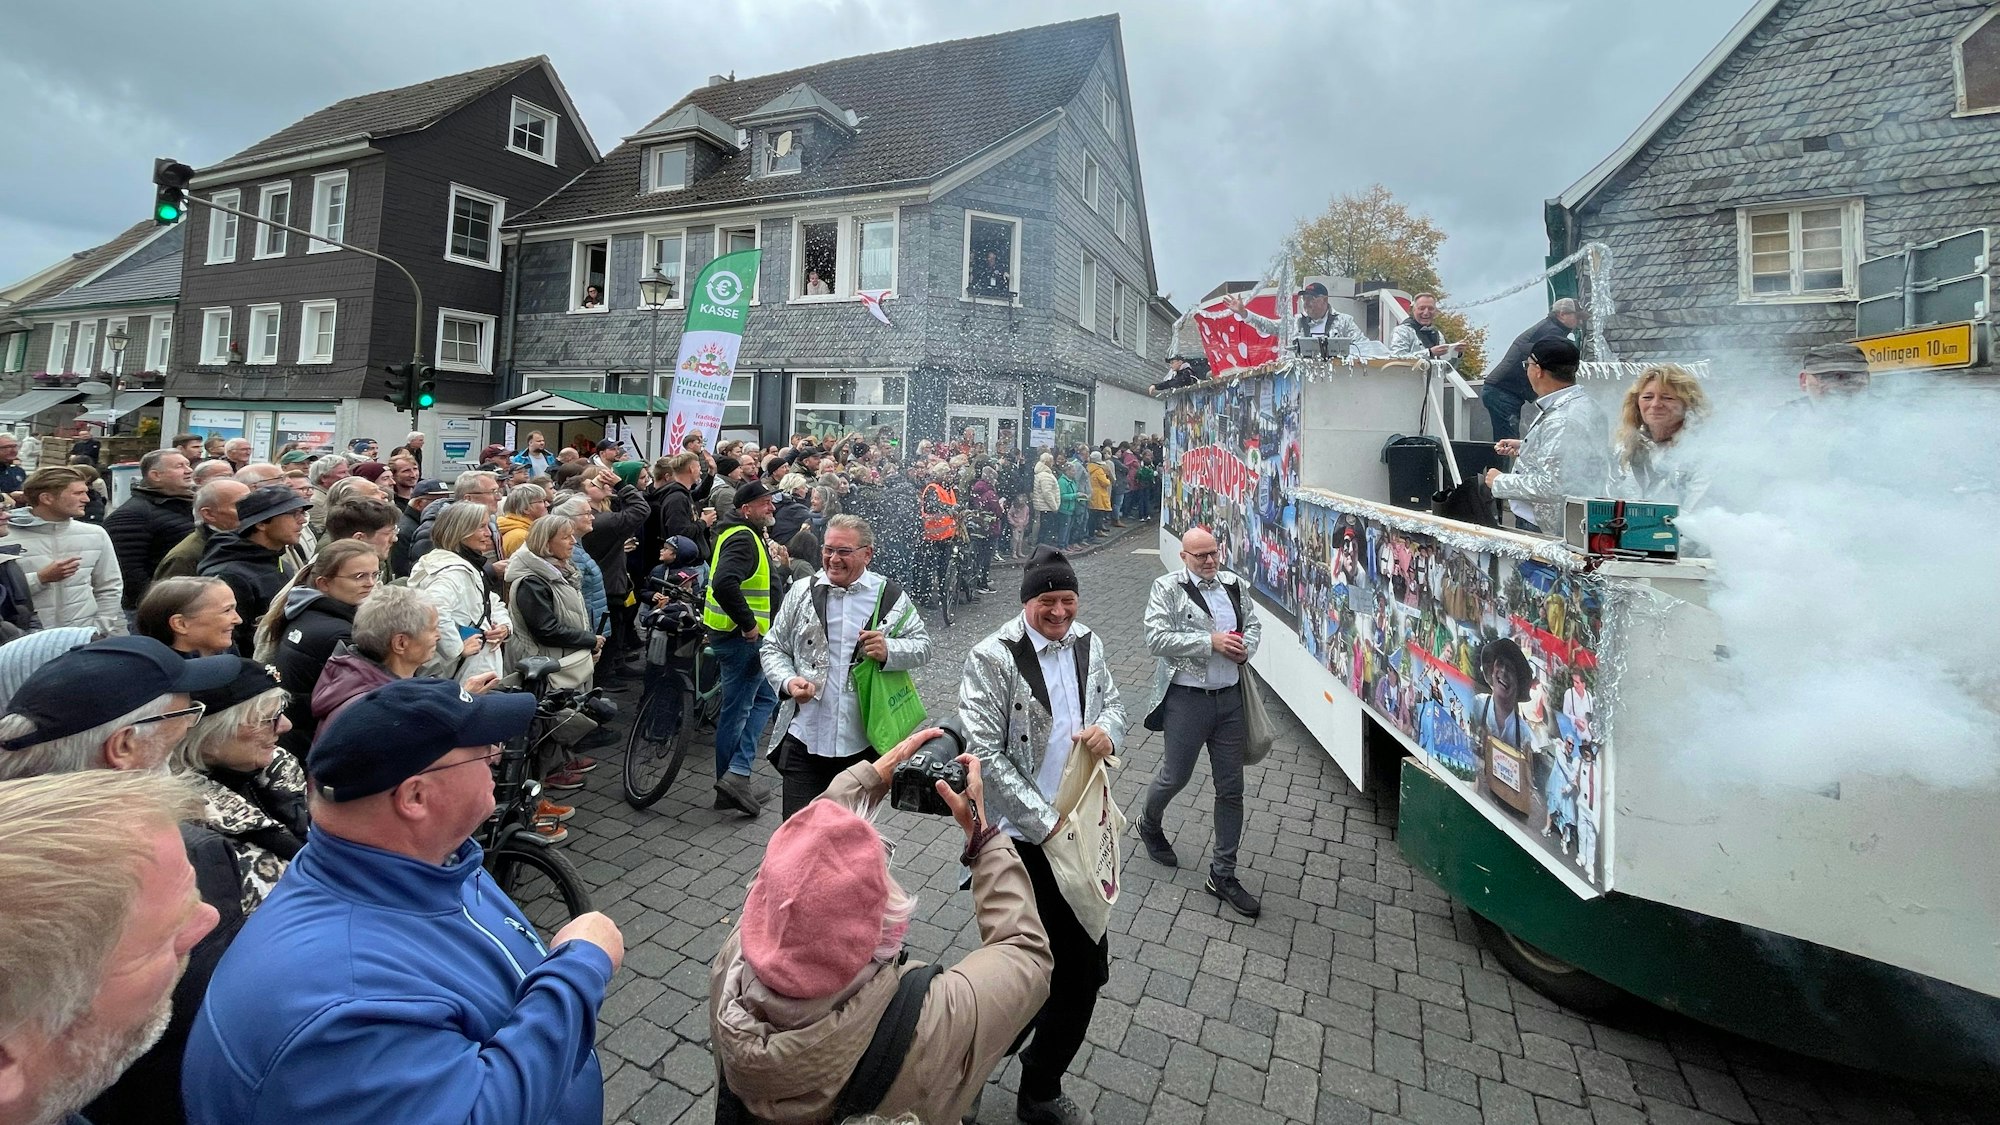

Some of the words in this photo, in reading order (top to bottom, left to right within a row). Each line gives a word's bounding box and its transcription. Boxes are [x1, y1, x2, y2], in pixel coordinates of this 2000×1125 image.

[699, 303, 740, 319] KASSE
[1869, 346, 1920, 363] Solingen
[1926, 340, 1940, 357] 10
[1942, 343, 1958, 355] km
[678, 376, 728, 393] Witzhelden
[676, 385, 727, 402] Erntedank
[287, 433, 298, 441] Das
